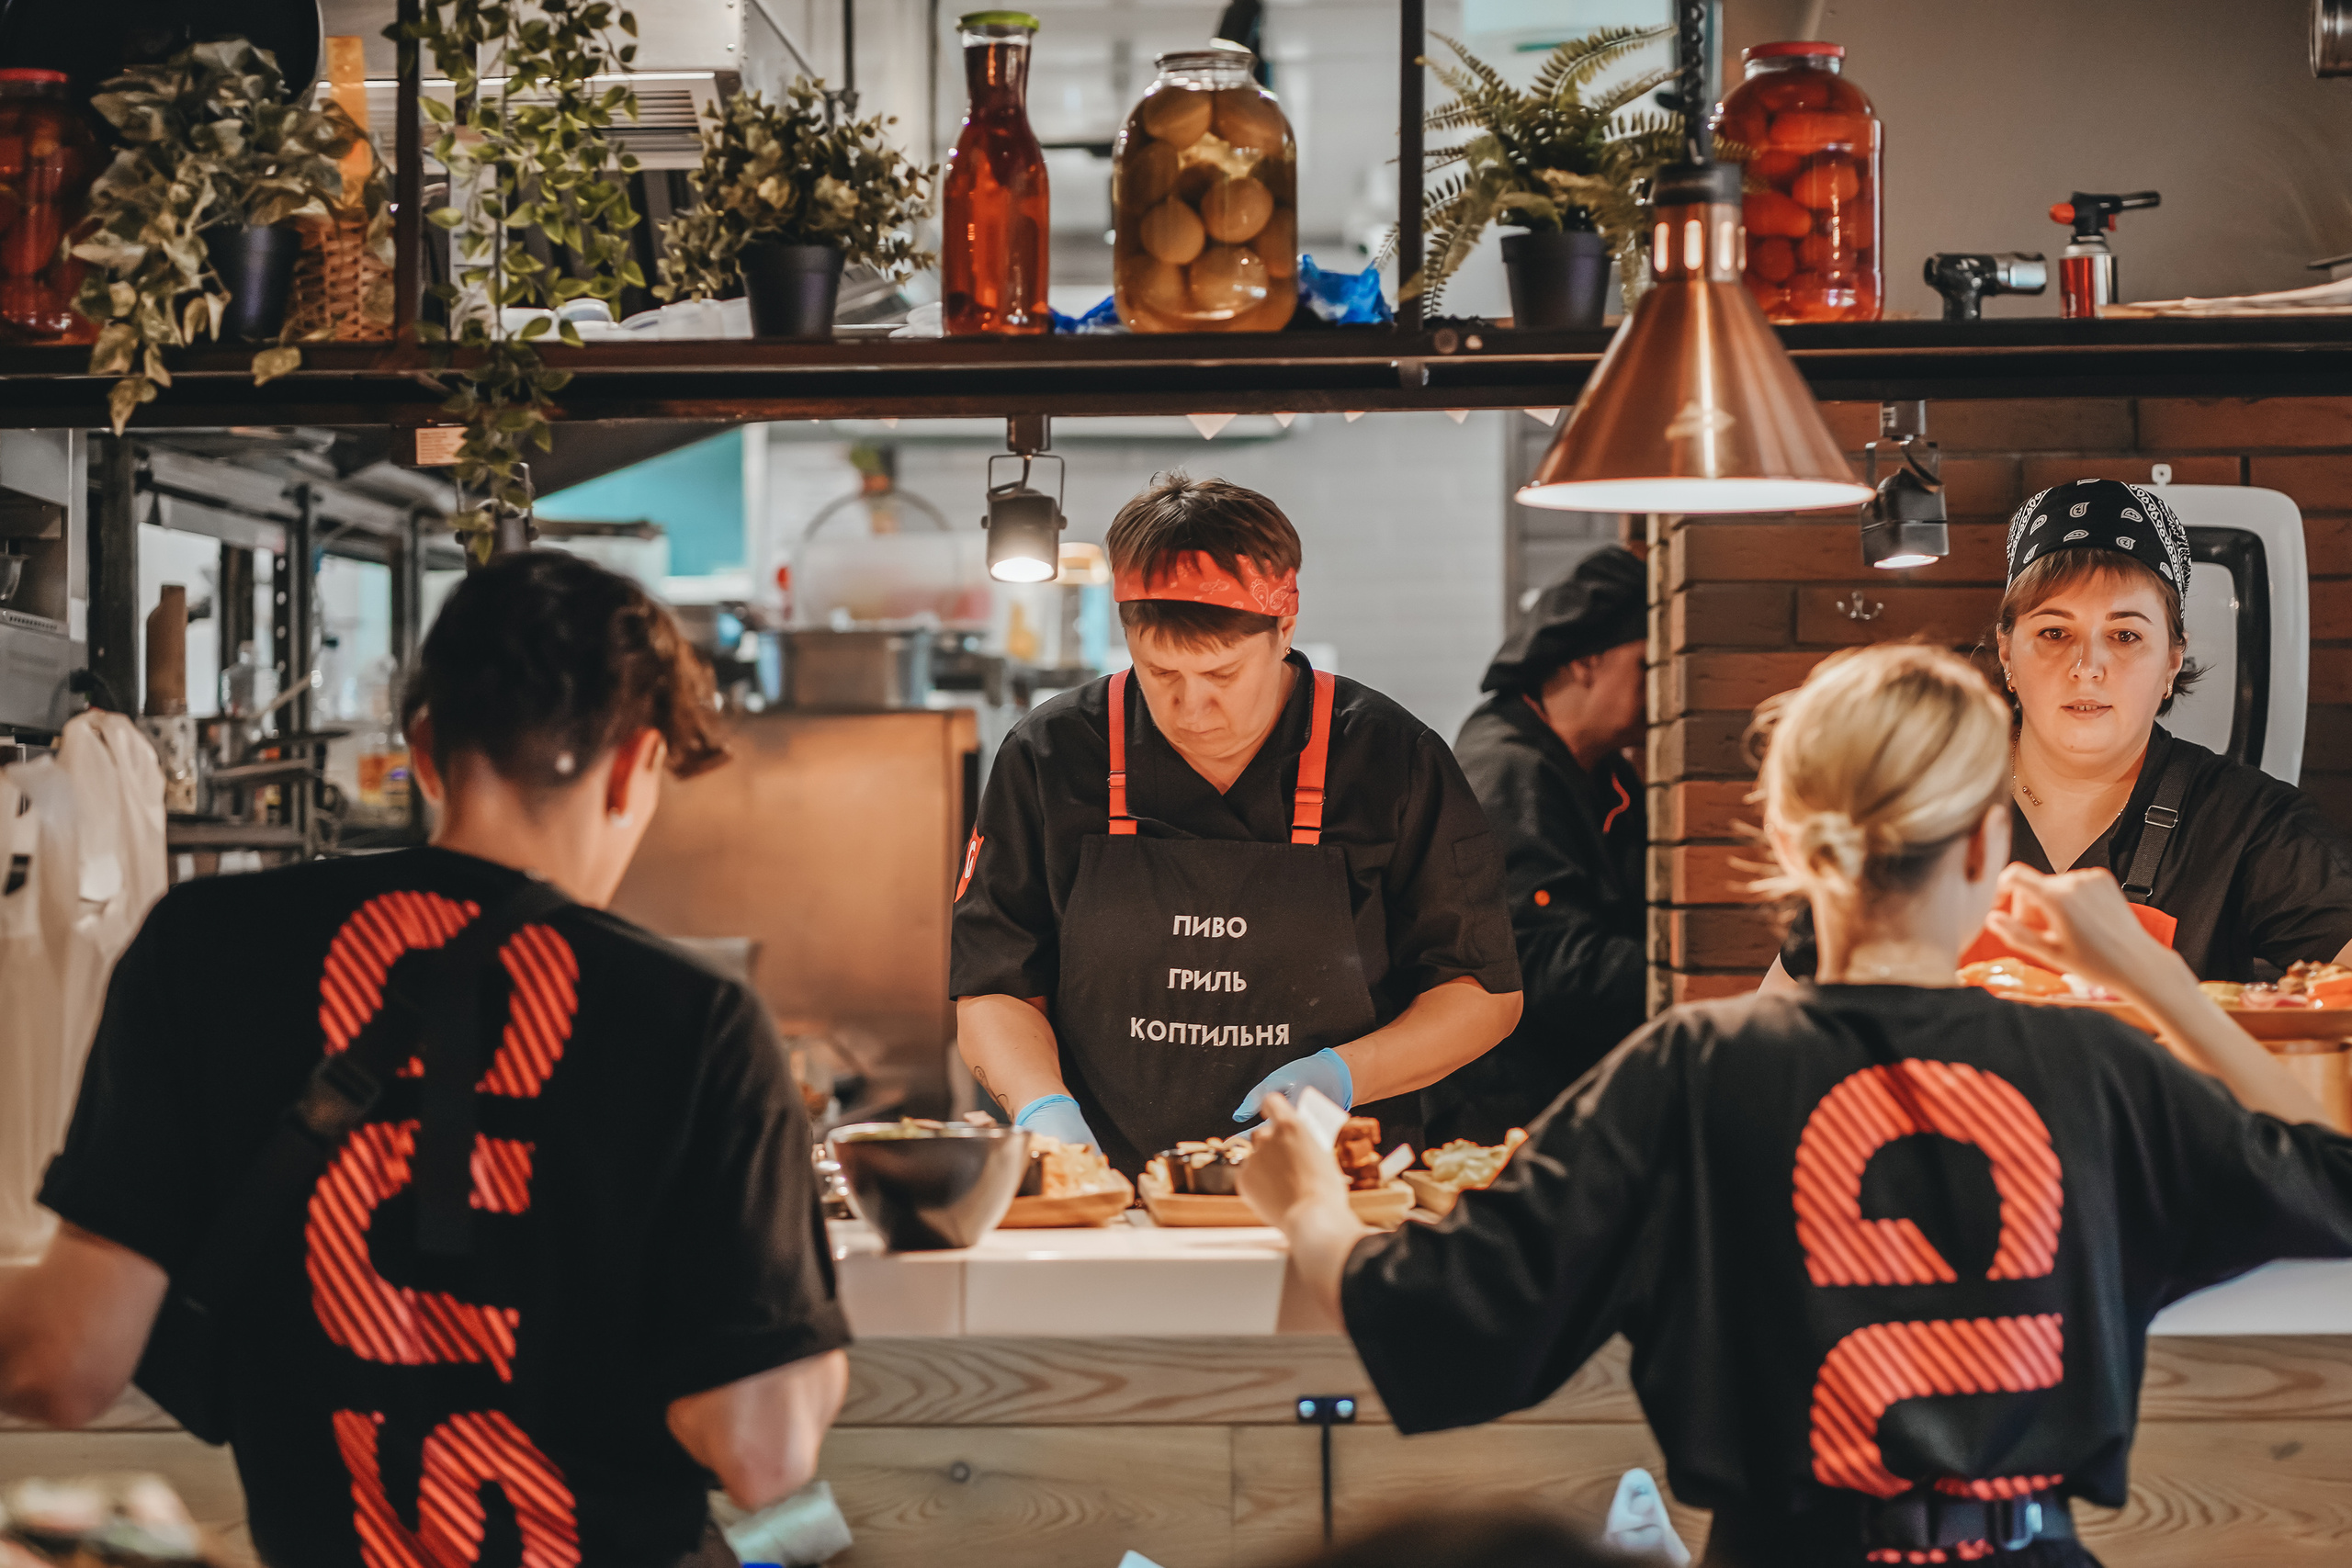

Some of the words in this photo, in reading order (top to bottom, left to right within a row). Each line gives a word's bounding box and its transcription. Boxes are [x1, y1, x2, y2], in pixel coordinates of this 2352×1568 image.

[1172, 915, 1248, 939] ПИВО
[1167, 968, 1248, 992] ГРИЛЬ
[1130, 1016, 1290, 1047] КОПТИЛЬНЯ
